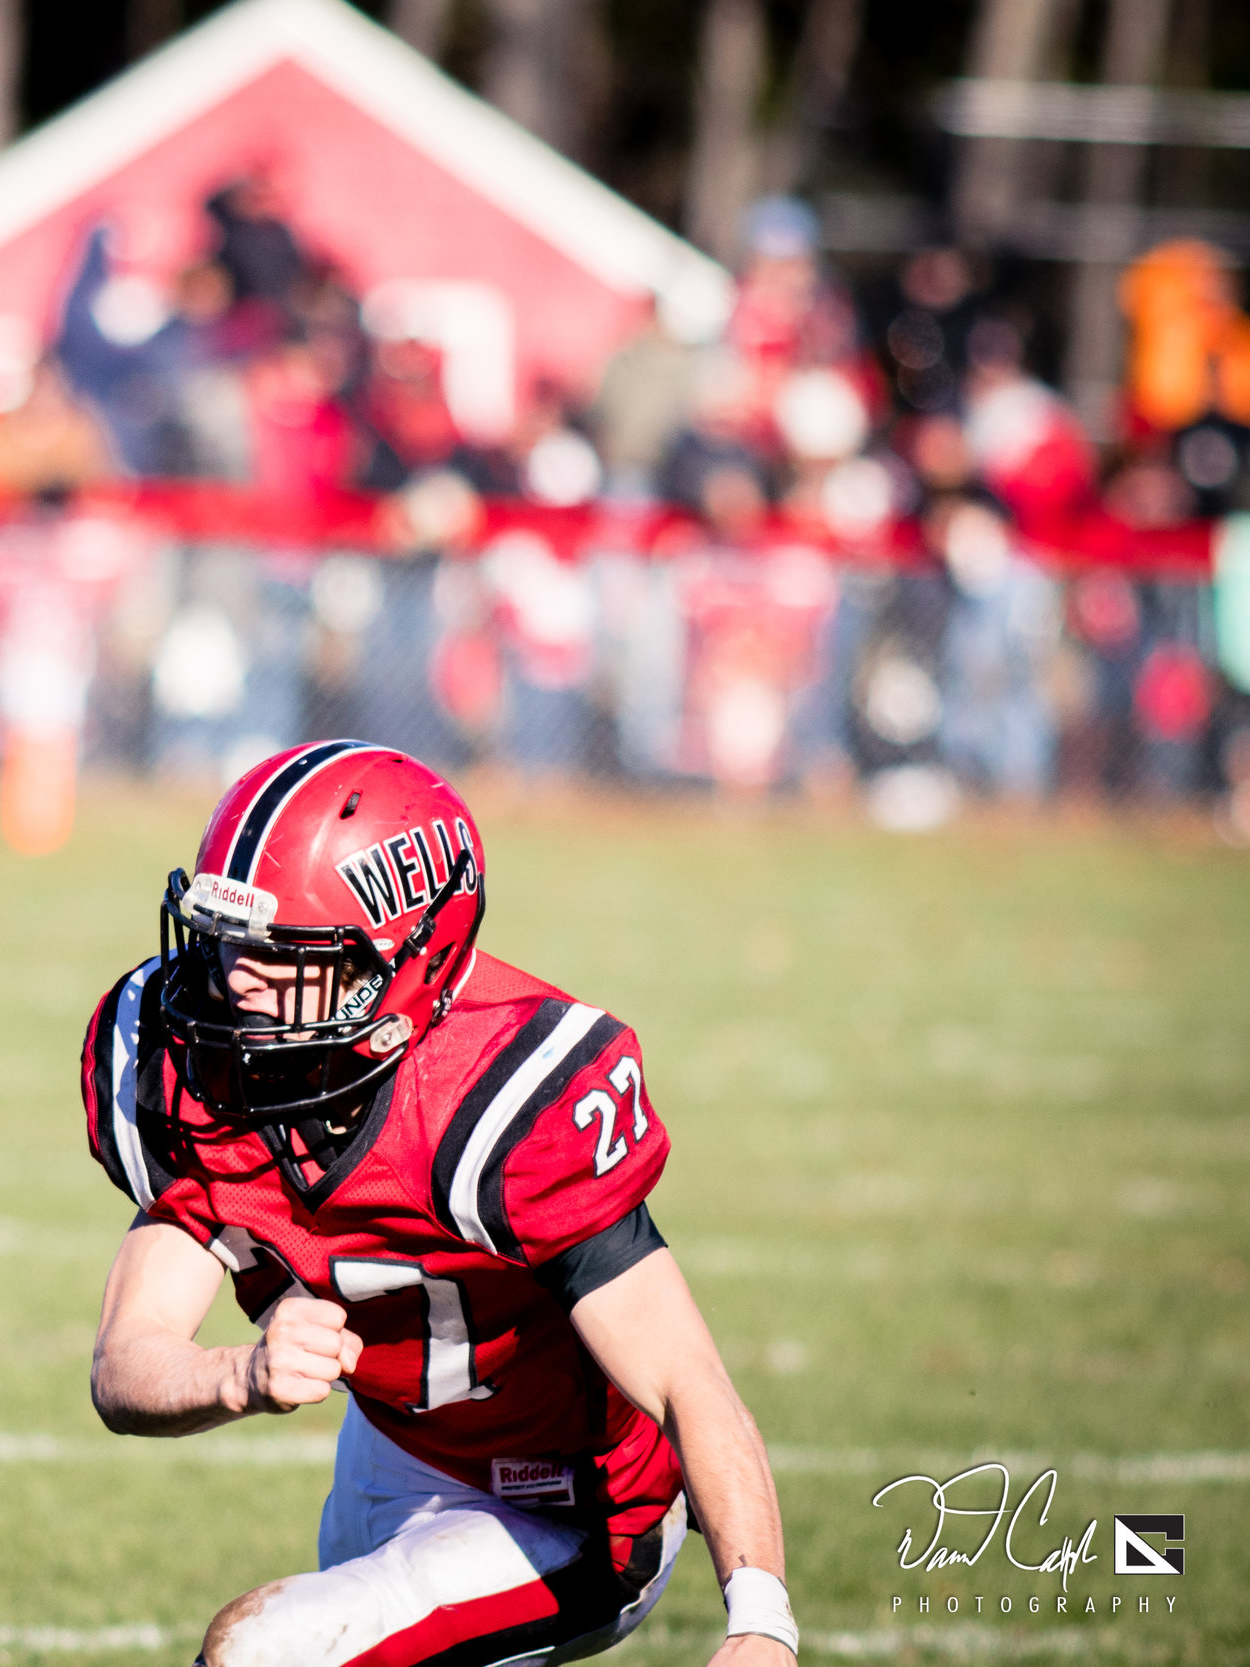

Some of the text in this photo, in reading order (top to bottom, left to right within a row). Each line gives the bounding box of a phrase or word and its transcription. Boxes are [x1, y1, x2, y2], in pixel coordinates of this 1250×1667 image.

[211, 881, 255, 908] Riddell
[335, 817, 478, 930] WELLS
[572, 1056, 649, 1180] 27
[499, 1464, 564, 1484] Riddell
